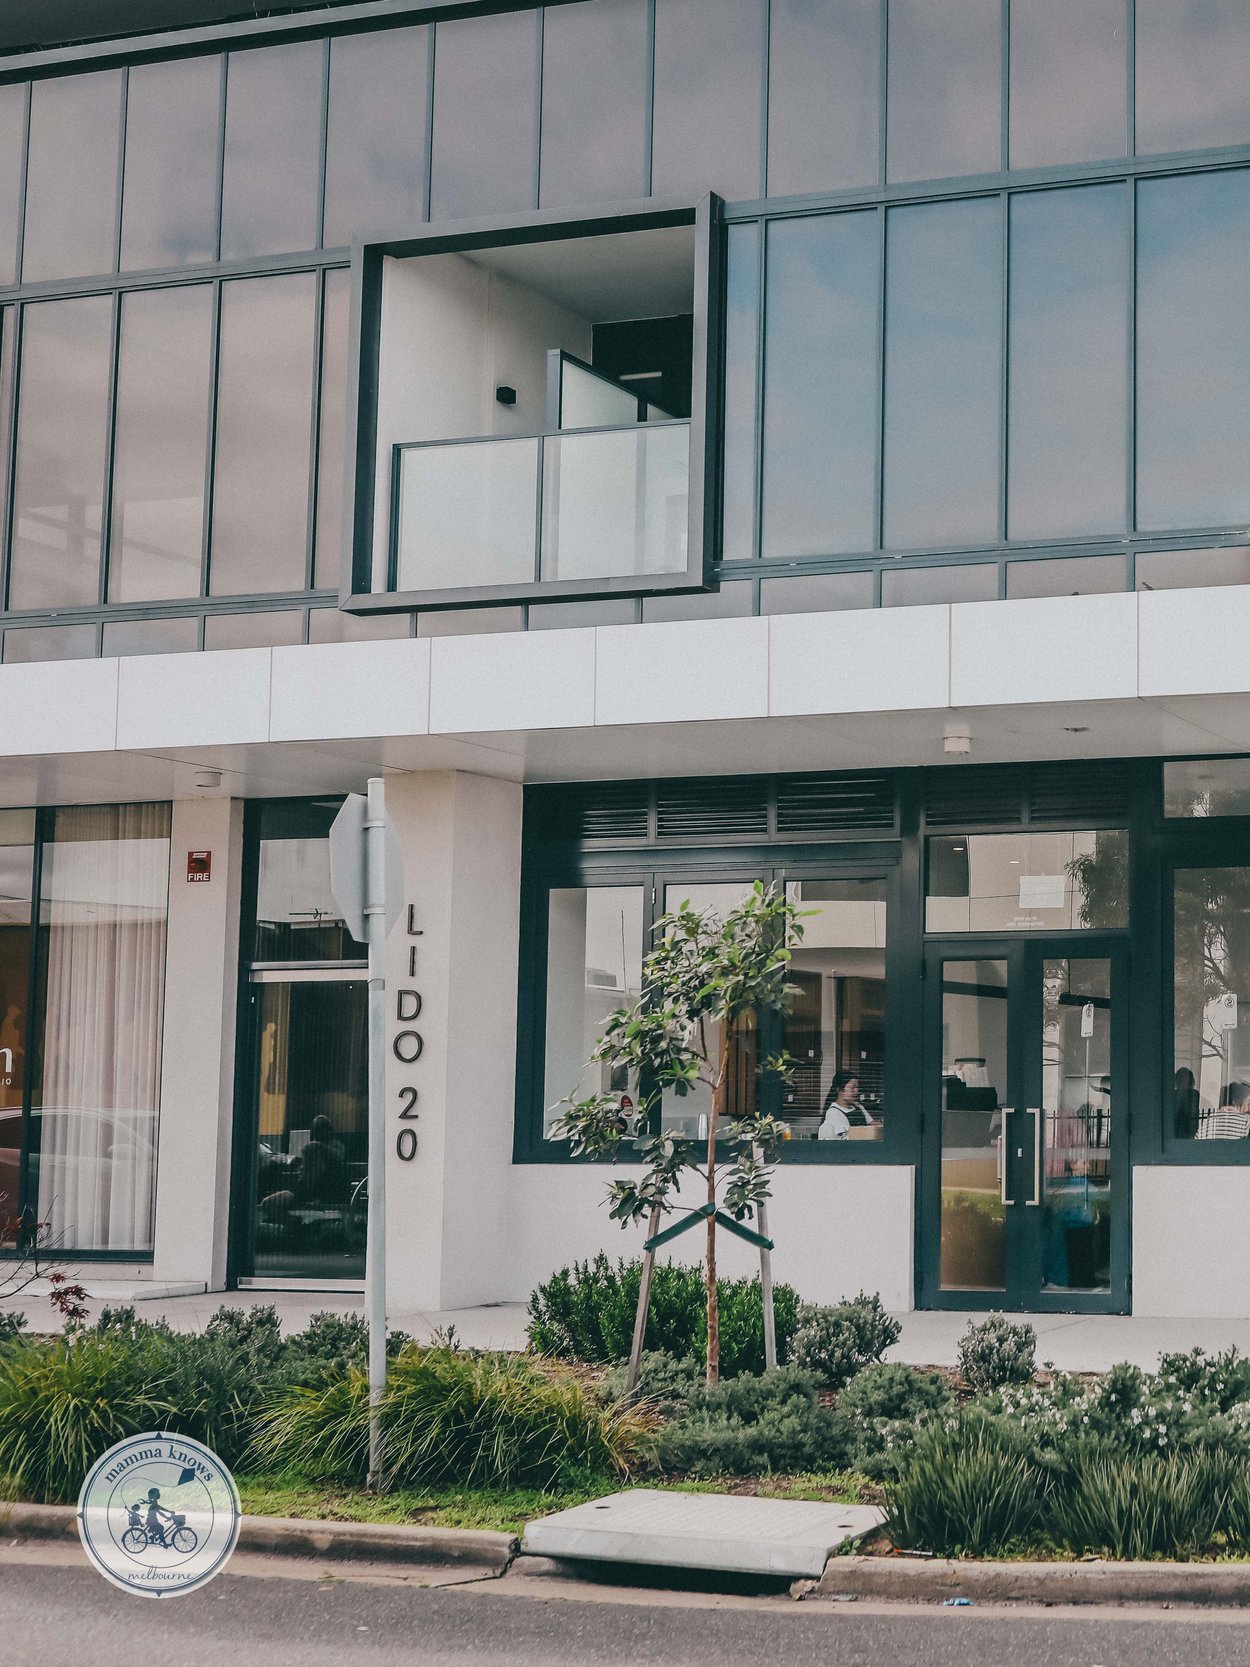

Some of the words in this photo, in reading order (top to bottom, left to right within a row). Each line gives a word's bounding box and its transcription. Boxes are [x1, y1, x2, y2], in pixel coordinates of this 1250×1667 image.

[188, 872, 210, 882] FIRE
[393, 903, 425, 1064] LIDO
[396, 1086, 419, 1162] 20
